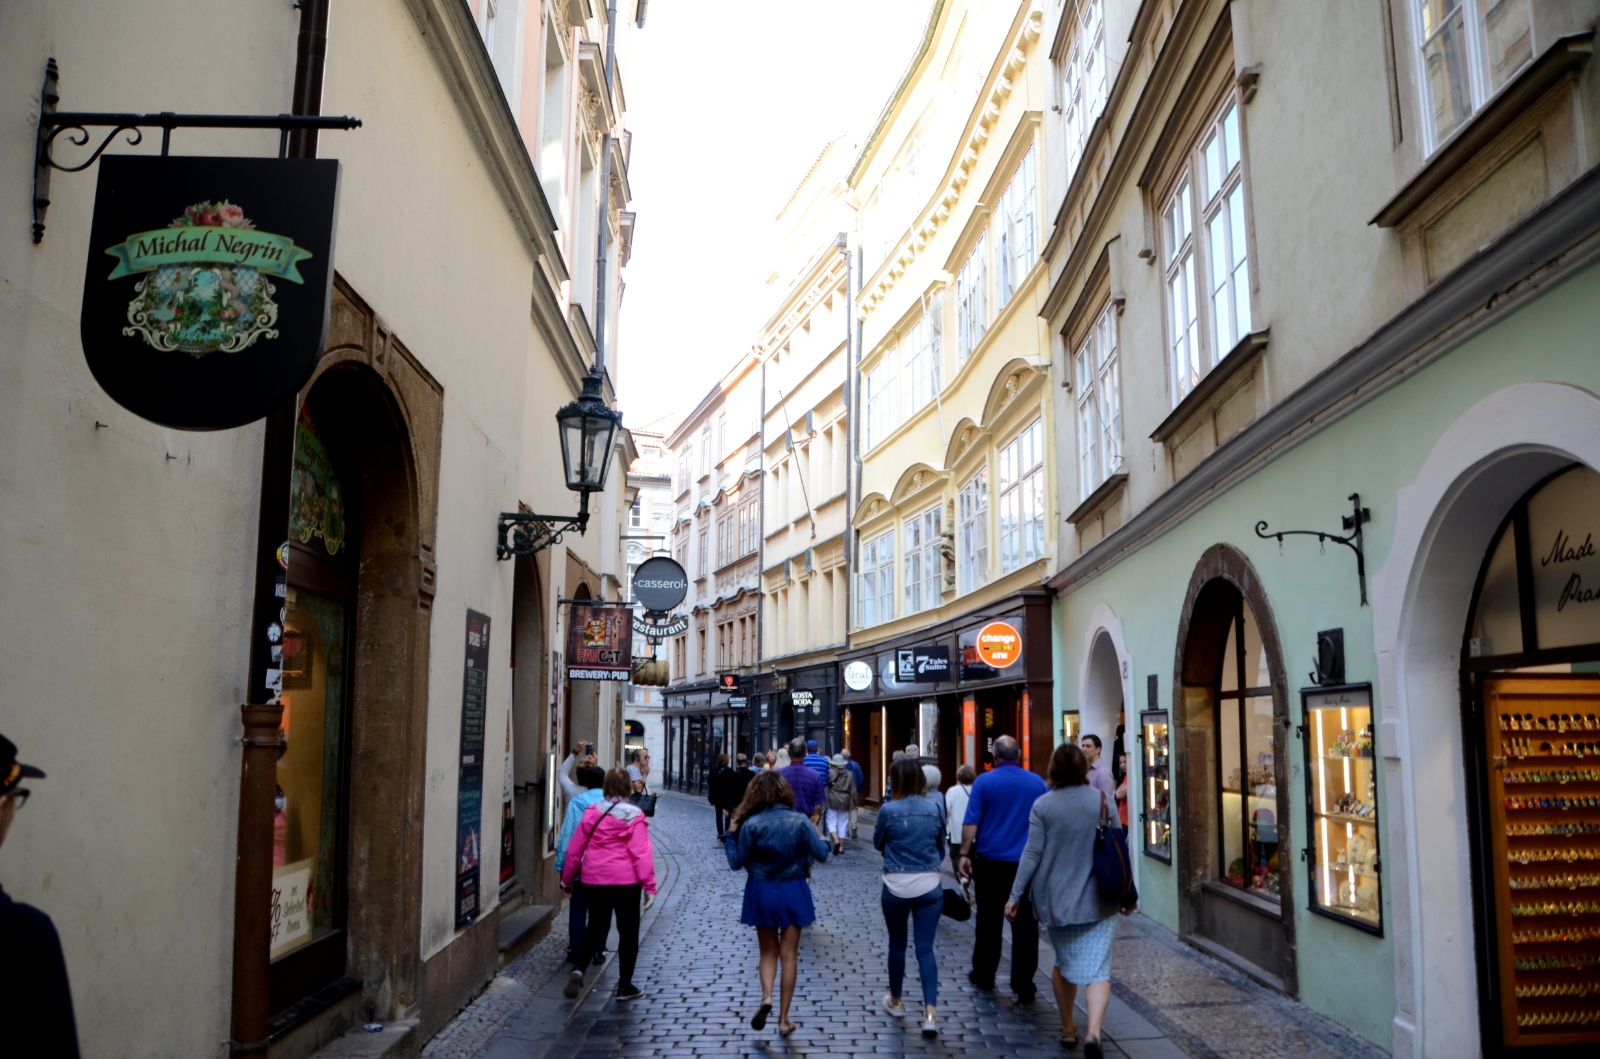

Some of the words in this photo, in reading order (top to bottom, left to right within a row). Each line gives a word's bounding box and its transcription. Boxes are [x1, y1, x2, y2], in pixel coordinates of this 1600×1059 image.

[135, 230, 212, 259] Michal
[214, 234, 283, 263] Negrin
[299, 432, 326, 472] Negrin
[1541, 529, 1597, 567] Made
[637, 578, 684, 589] casserol
[633, 620, 687, 636] estaurant
[981, 634, 1016, 645] change
[991, 652, 1008, 660] ATM
[916, 656, 929, 674] 7
[569, 669, 609, 680] BREWERY
[611, 671, 629, 680] PUB
[848, 666, 870, 680] local
[791, 691, 813, 699] KOSTA
[793, 698, 812, 706] BODA
